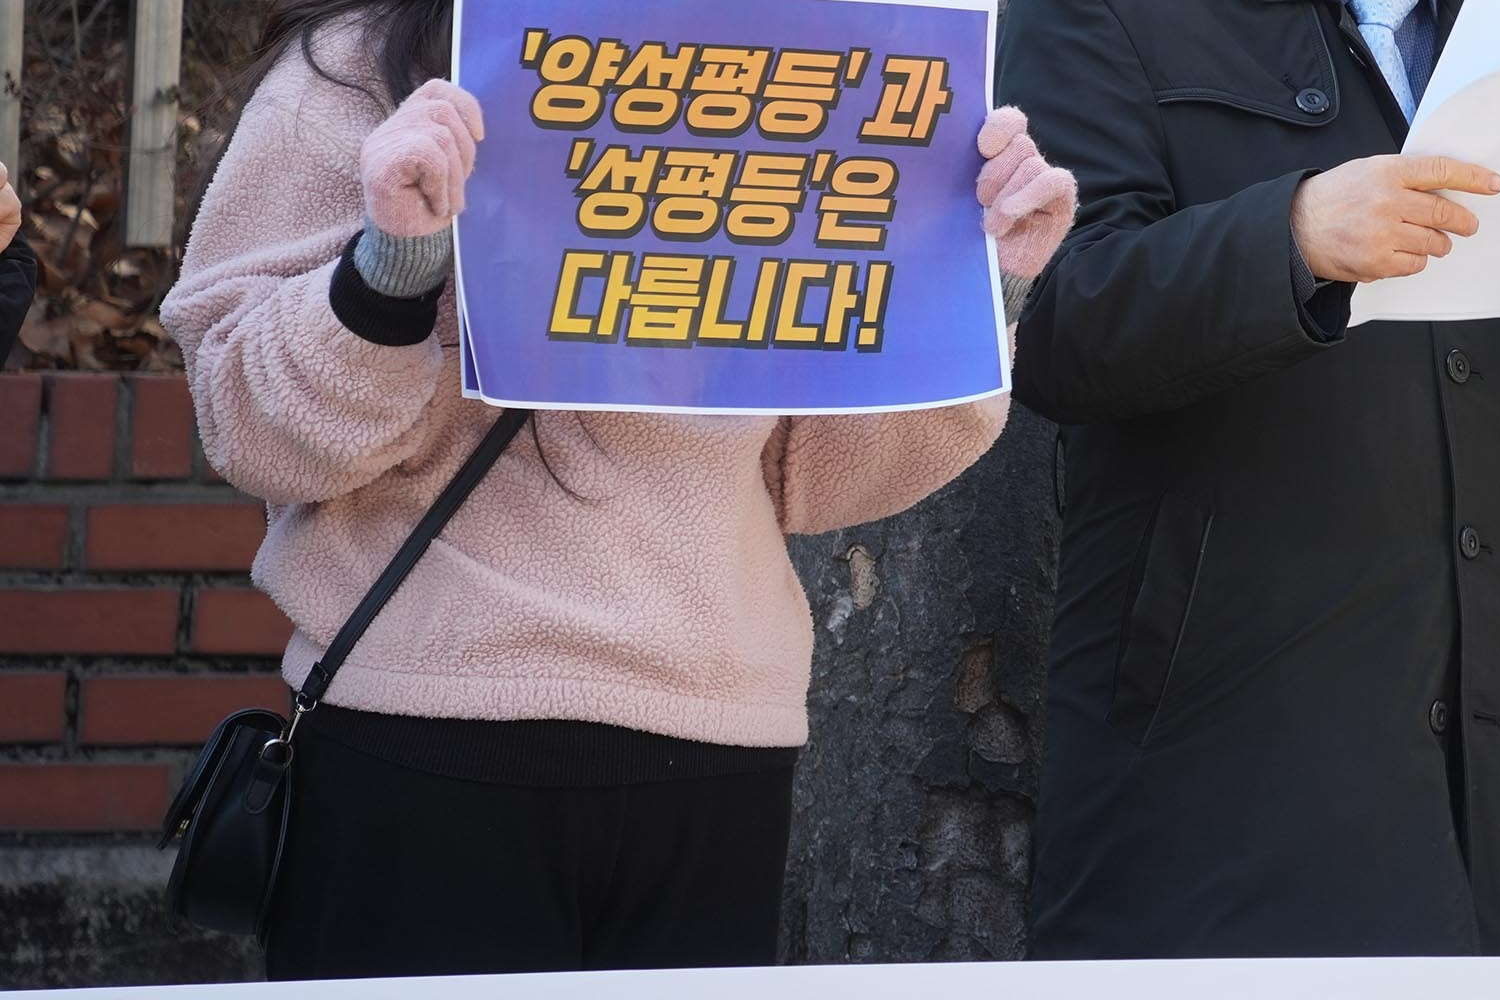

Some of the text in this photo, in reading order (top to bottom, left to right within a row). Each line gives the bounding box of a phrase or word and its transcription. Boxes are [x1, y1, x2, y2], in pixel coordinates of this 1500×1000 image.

[521, 28, 952, 146] '양성평등' 과
[565, 138, 900, 250] '성평등'은
[547, 249, 893, 352] 다릅니다!
